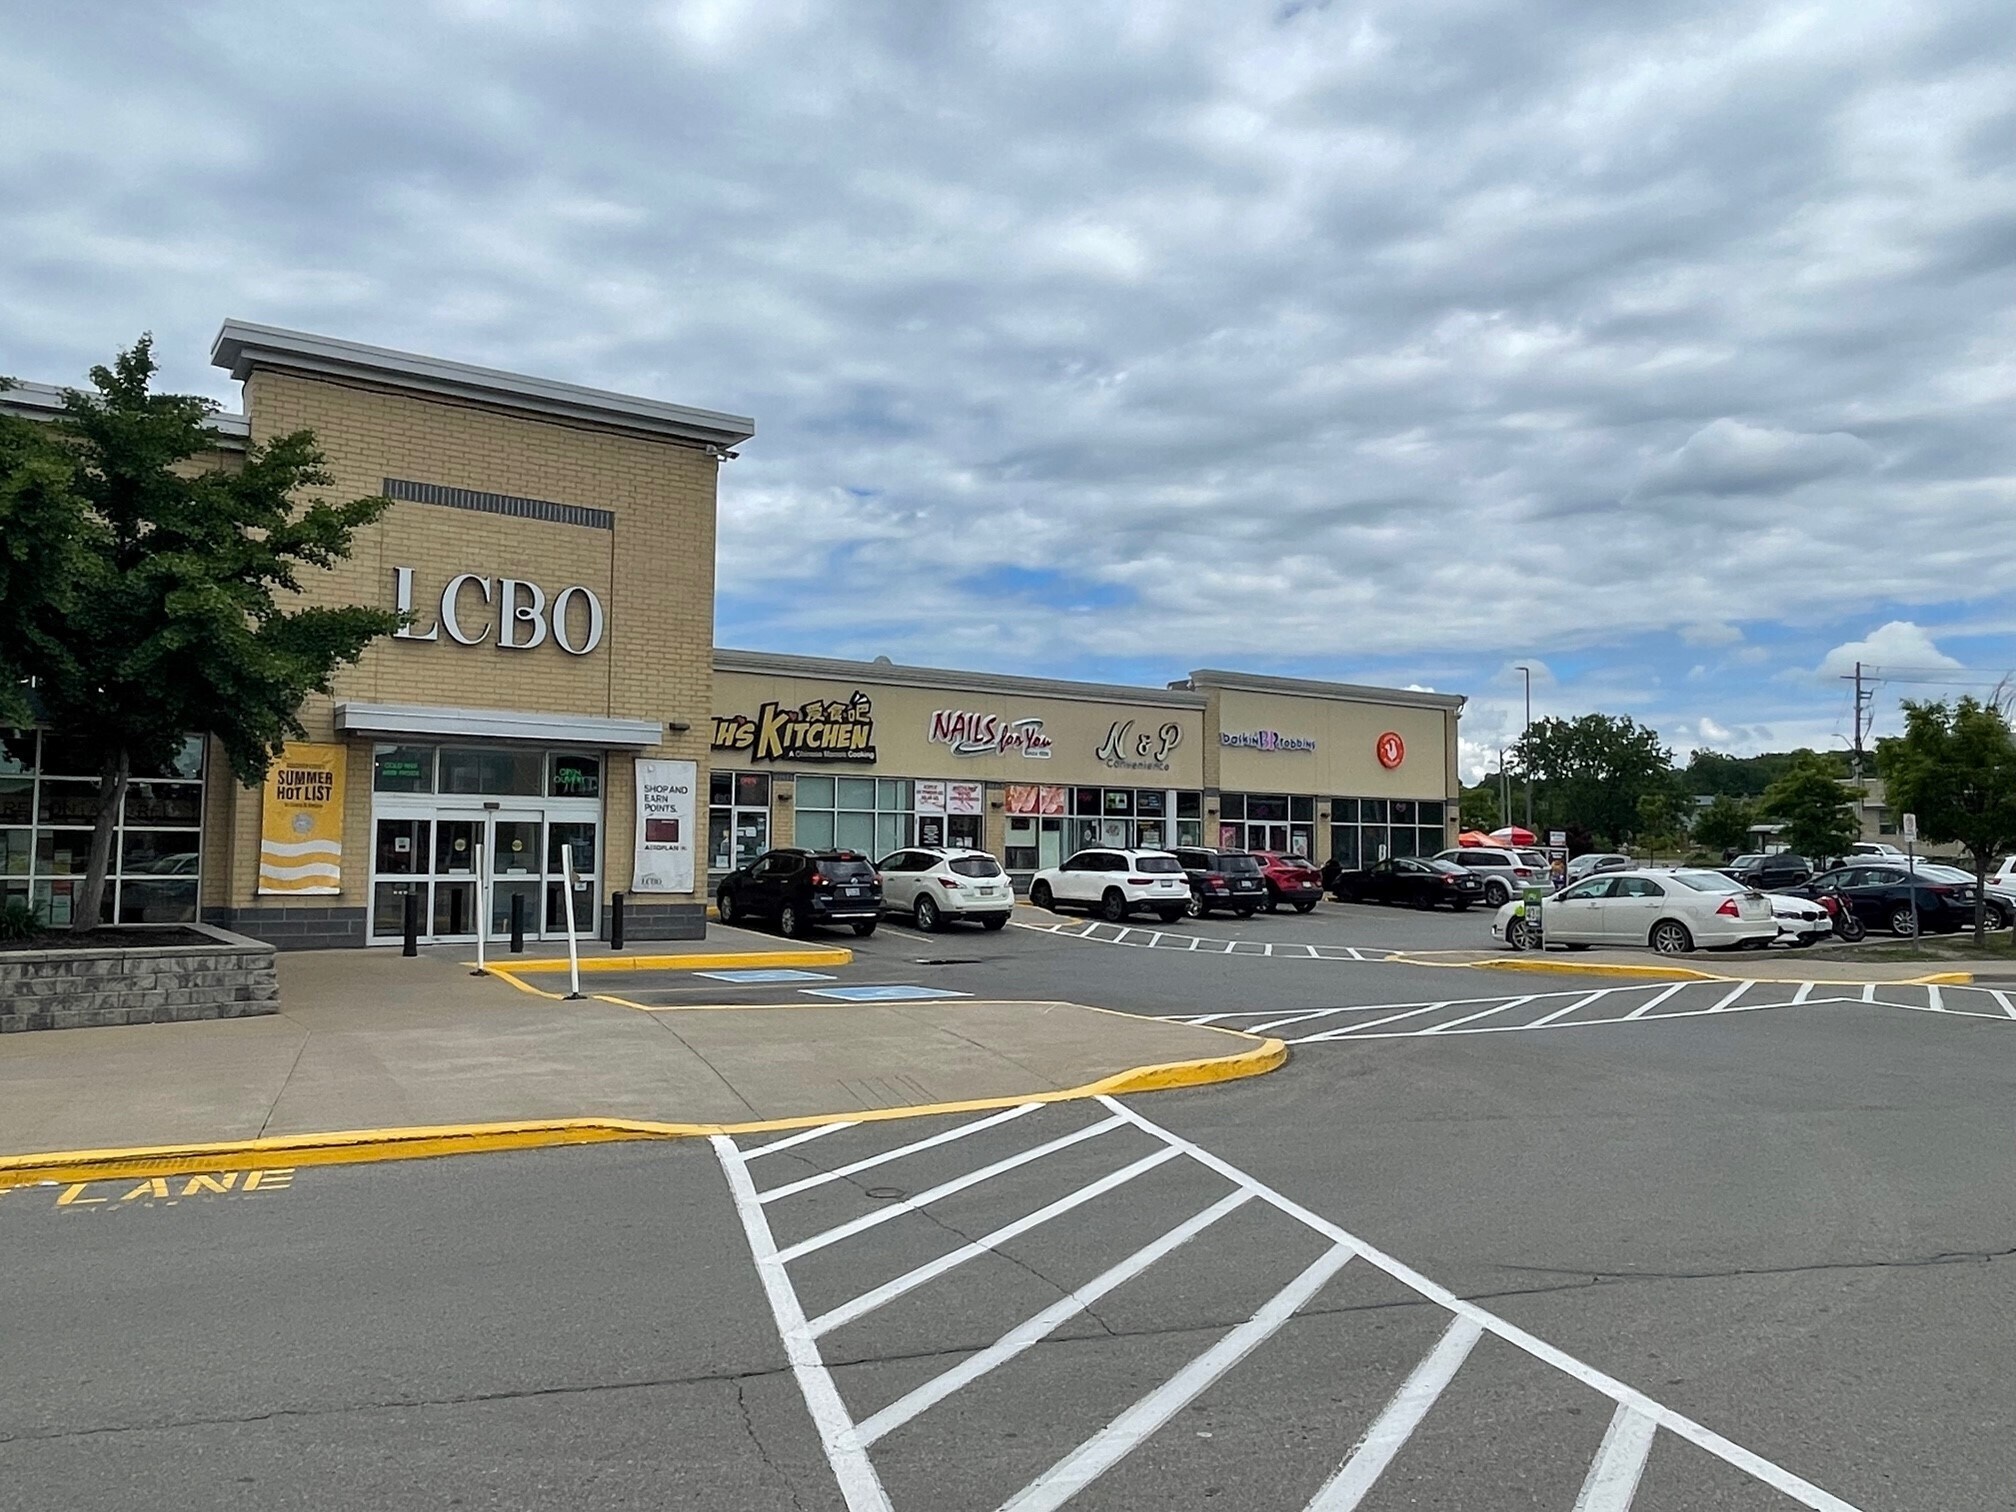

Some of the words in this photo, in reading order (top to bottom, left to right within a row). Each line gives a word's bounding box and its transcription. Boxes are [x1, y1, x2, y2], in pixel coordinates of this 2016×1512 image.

[393, 566, 604, 655] LCBO
[756, 704, 870, 758] KITCHEN
[929, 710, 997, 745] NAILS
[998, 723, 1023, 753] for
[1024, 726, 1053, 750] You
[1136, 733, 1152, 756] &
[1154, 722, 1184, 762] P
[1106, 758, 1170, 772] Convenience
[277, 770, 333, 786] SUMMER
[276, 786, 302, 800] HOT
[304, 786, 332, 801] LIST
[644, 784, 668, 793] SHOP
[668, 786, 688, 794] AND
[644, 794, 669, 803] EARN
[644, 804, 678, 813] POINTS.
[57, 1169, 295, 1206] LANE
